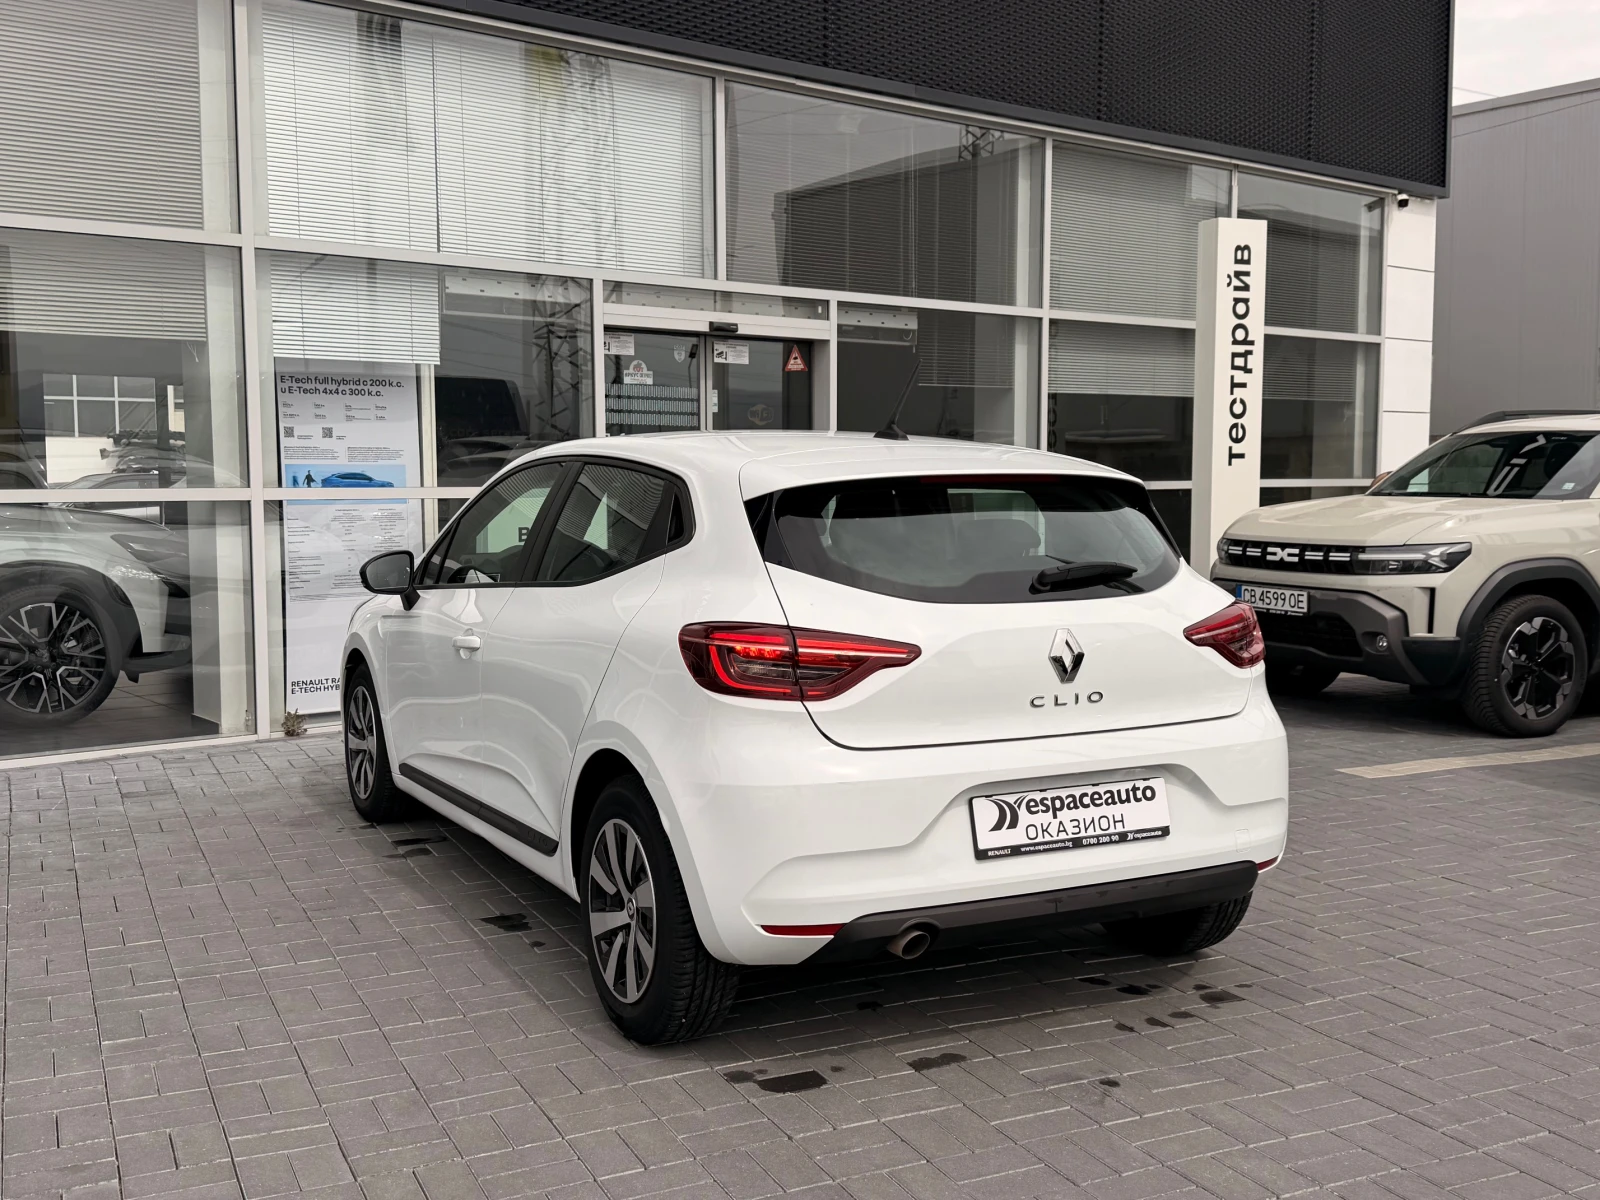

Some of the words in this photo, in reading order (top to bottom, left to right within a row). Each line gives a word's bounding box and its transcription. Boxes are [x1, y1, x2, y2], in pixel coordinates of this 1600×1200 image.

[1227, 244, 1256, 466] тестдрайв
[280, 375, 313, 385] E-Tech
[314, 376, 329, 385] full
[331, 377, 361, 387] hybrid
[370, 379, 387, 388] 200
[288, 386, 321, 395] E-Tech
[322, 387, 340, 396] 4x4
[348, 388, 367, 397] 300
[1259, 590, 1286, 607] 4599
[291, 678, 329, 687] RENAULT
[291, 686, 322, 695] E-TECH
[1029, 691, 1104, 708] CLIO
[1025, 783, 1157, 819] espaceauto
[1026, 813, 1126, 841] ОКАЗИОН
[1021, 841, 1072, 851] www.espaceauto.bg
[1082, 838, 1098, 846] 0700
[1099, 836, 1110, 844] 200
[1111, 834, 1119, 842] 90
